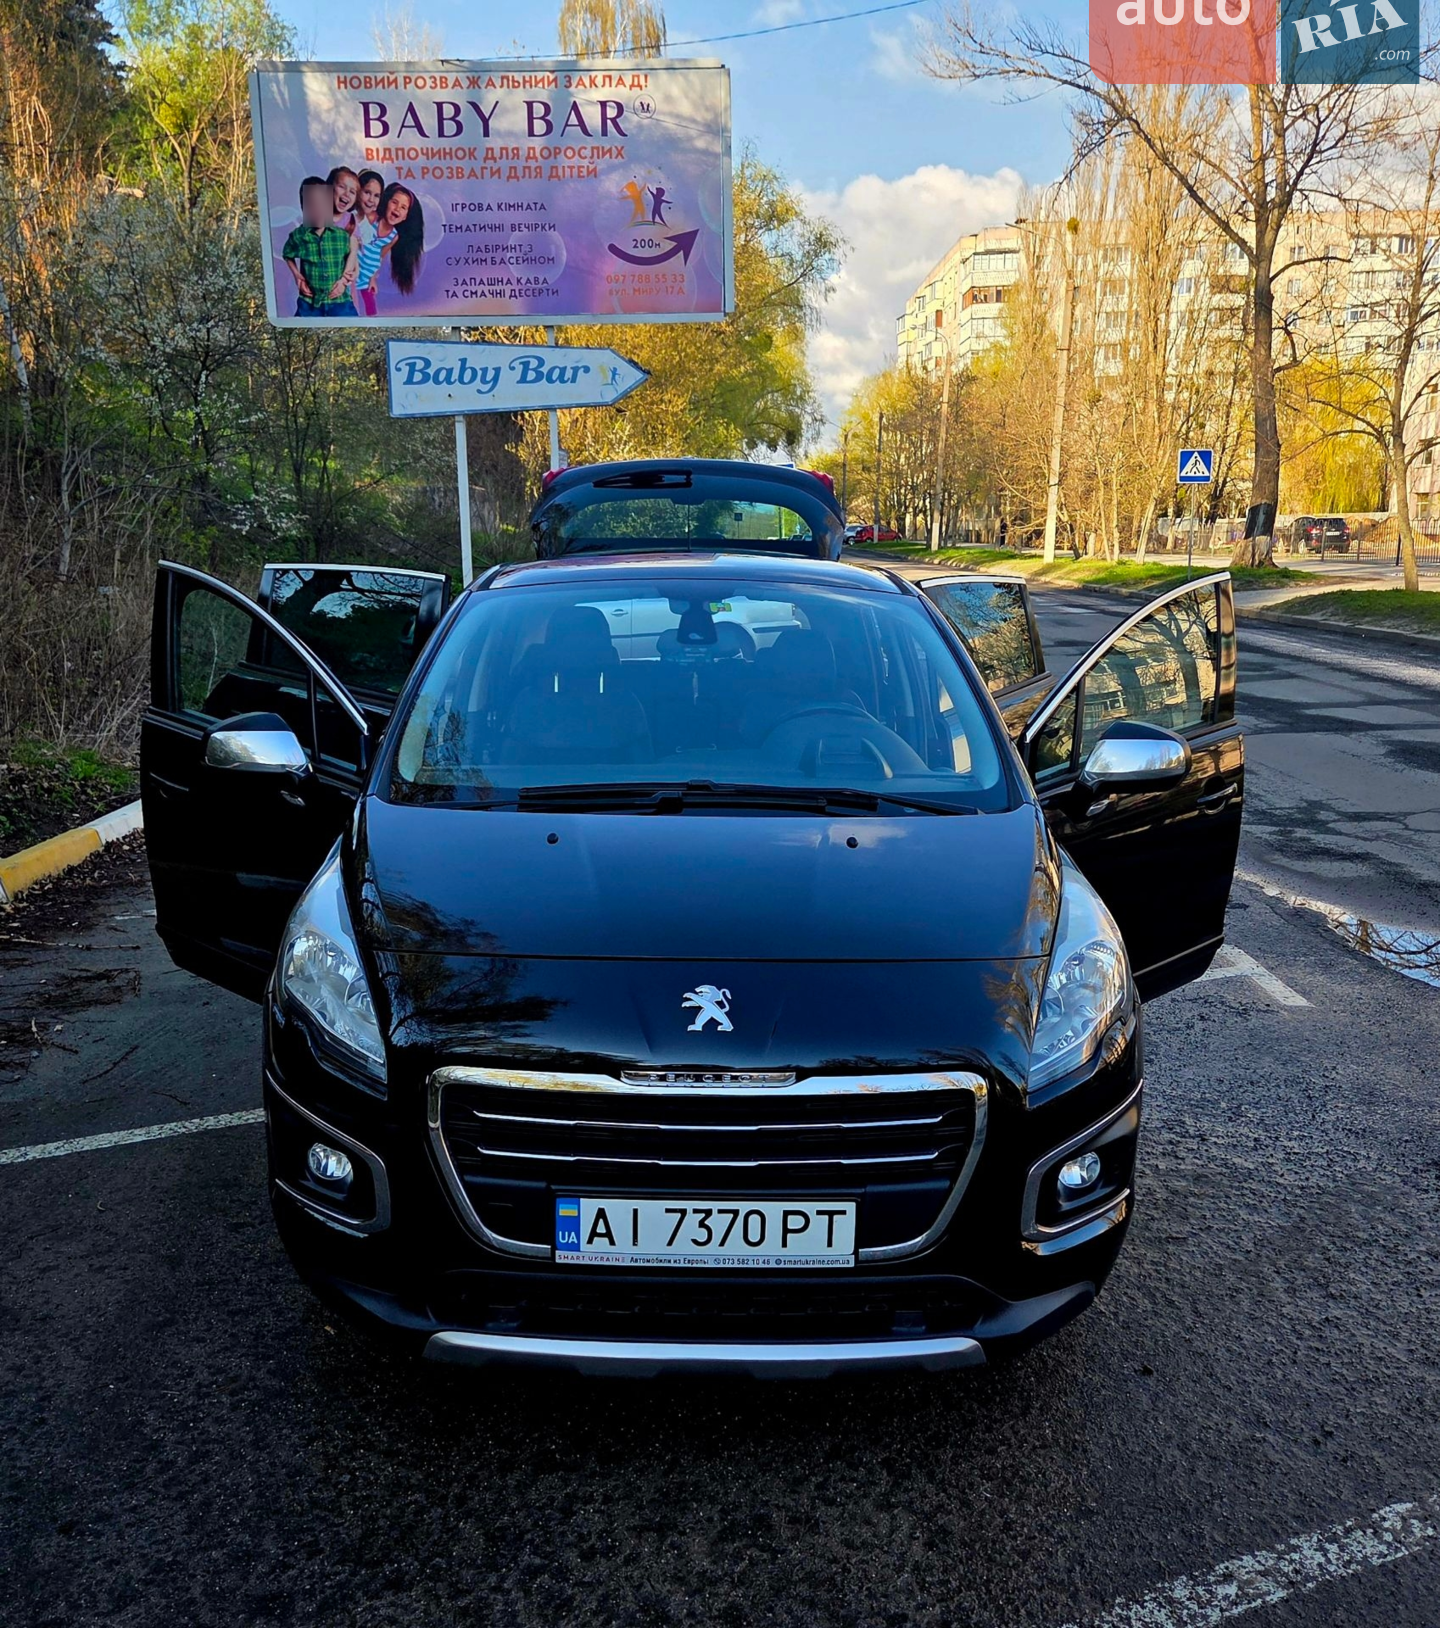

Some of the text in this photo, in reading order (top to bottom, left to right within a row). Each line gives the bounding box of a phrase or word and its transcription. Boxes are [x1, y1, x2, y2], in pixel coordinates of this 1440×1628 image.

[337, 71, 649, 90] НОВИЙ РОЗВАЖАЛЬНИЙ ЗАКЛАД!
[359, 100, 628, 138] BABY BAR
[365, 145, 625, 162] ВІДПОЧИНОК ДЛЯ ДОРОСЛИХ
[396, 162, 598, 180] ТА РОЗВАГИ ДЛЯ ДІТЕЙ
[451, 201, 548, 213] ІГРОВА КІМНАТА
[441, 222, 557, 234] ТЕМАТИЧНІ ВЕЧІРКИ
[466, 243, 534, 254] ЛАБІРИНТ З
[445, 251, 556, 267] СУХИМ БАСЕЙНОМ
[452, 276, 550, 288] ЗАПАШНА КАВА
[606, 273, 686, 285] 097 788 55 33
[444, 288, 560, 300] ТА СМАЧНІ ДЕСЕРТИ
[665, 286, 675, 295] 17
[394, 354, 591, 395] Baby Bar
[664, 1207, 767, 1248] 7370
[559, 1231, 578, 1244] UA
[557, 1254, 586, 1262] SMART
